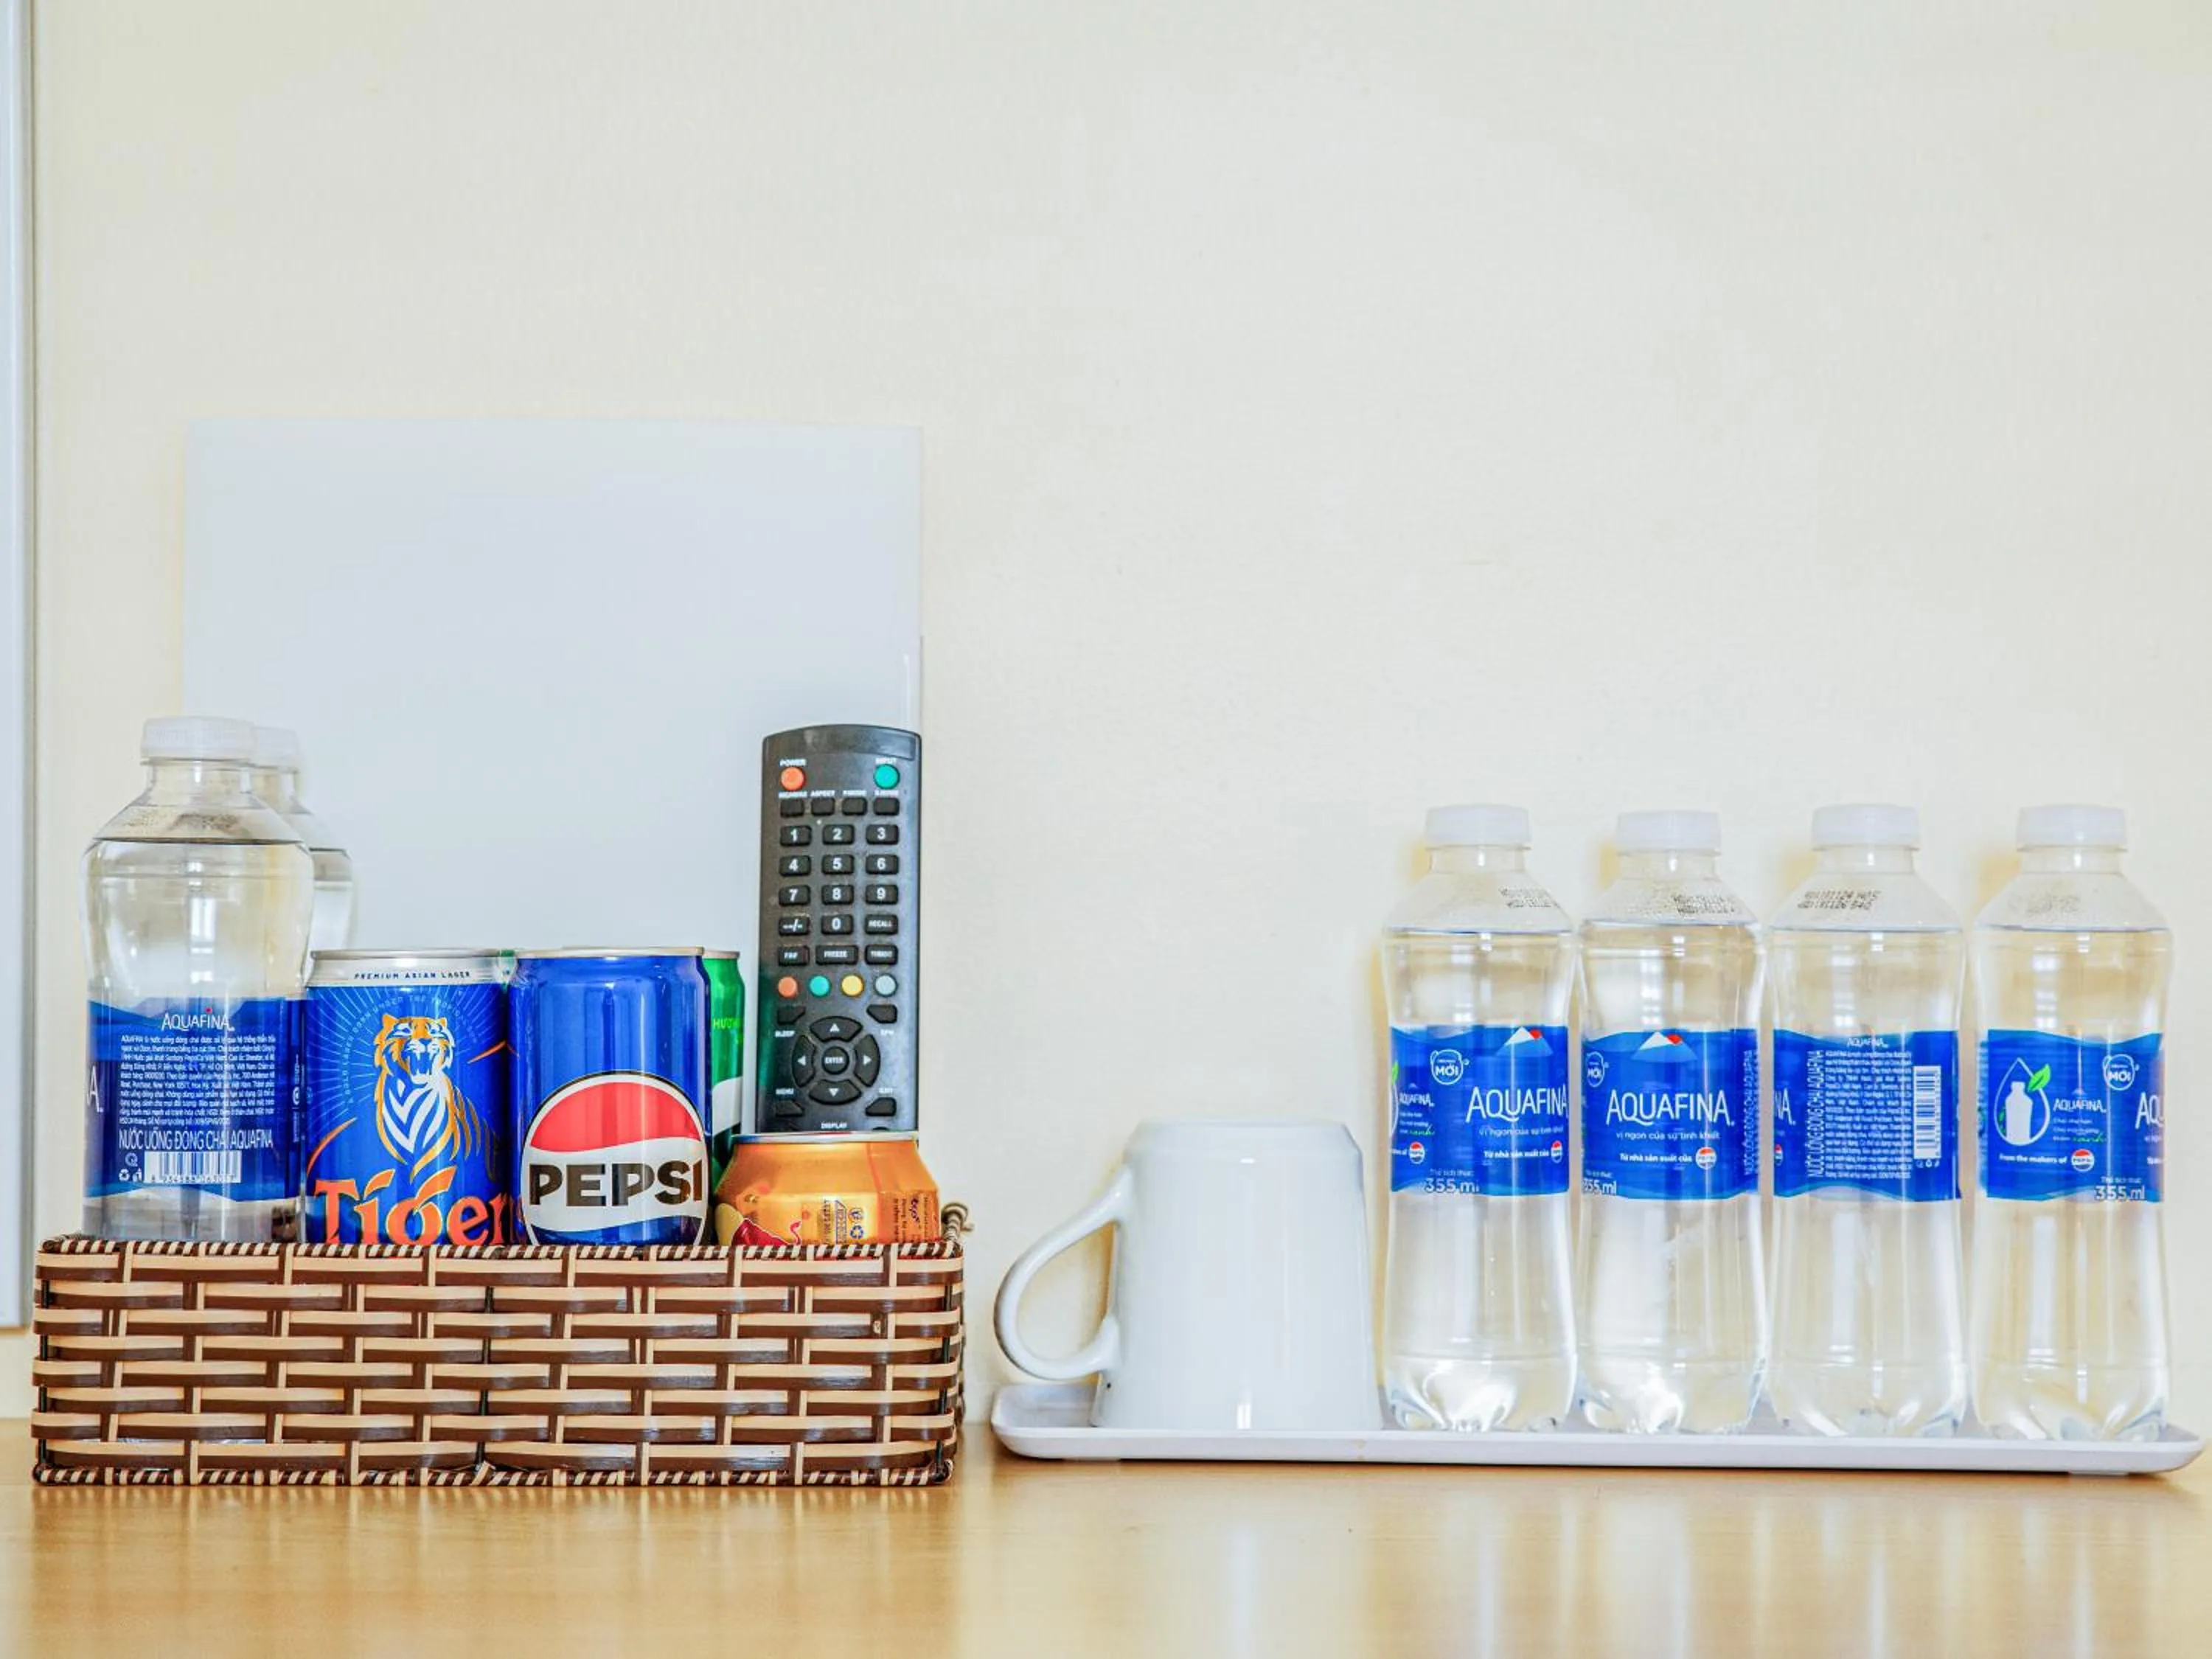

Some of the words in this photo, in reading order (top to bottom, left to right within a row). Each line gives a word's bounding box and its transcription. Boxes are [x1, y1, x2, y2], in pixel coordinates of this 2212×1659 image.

[790, 830, 798, 841] 1
[833, 828, 842, 840] 2
[877, 827, 886, 839] 3
[789, 859, 798, 871] 4
[833, 858, 841, 870] 5
[877, 858, 886, 870] 6
[789, 889, 798, 901] 7
[832, 888, 841, 900] 8
[877, 888, 886, 900] 9
[831, 917, 841, 930] 0
[442, 970, 470, 978] LAGER
[161, 1012, 231, 1032] AQUAFINA
[1465, 1083, 1568, 1123] AQUAFINA
[1606, 1089, 1732, 1126] AQUAFINA
[2053, 1099, 2102, 1113] AQUAFINA
[232, 1129, 274, 1150] AQUAFINA
[529, 1160, 703, 1208] PEPSI
[1425, 1178, 1456, 1192] 355
[1602, 1180, 1616, 1194] ml
[2096, 1185, 2127, 1200] 355
[2130, 1185, 2145, 1200] ml
[314, 1166, 507, 1245] Tiger
